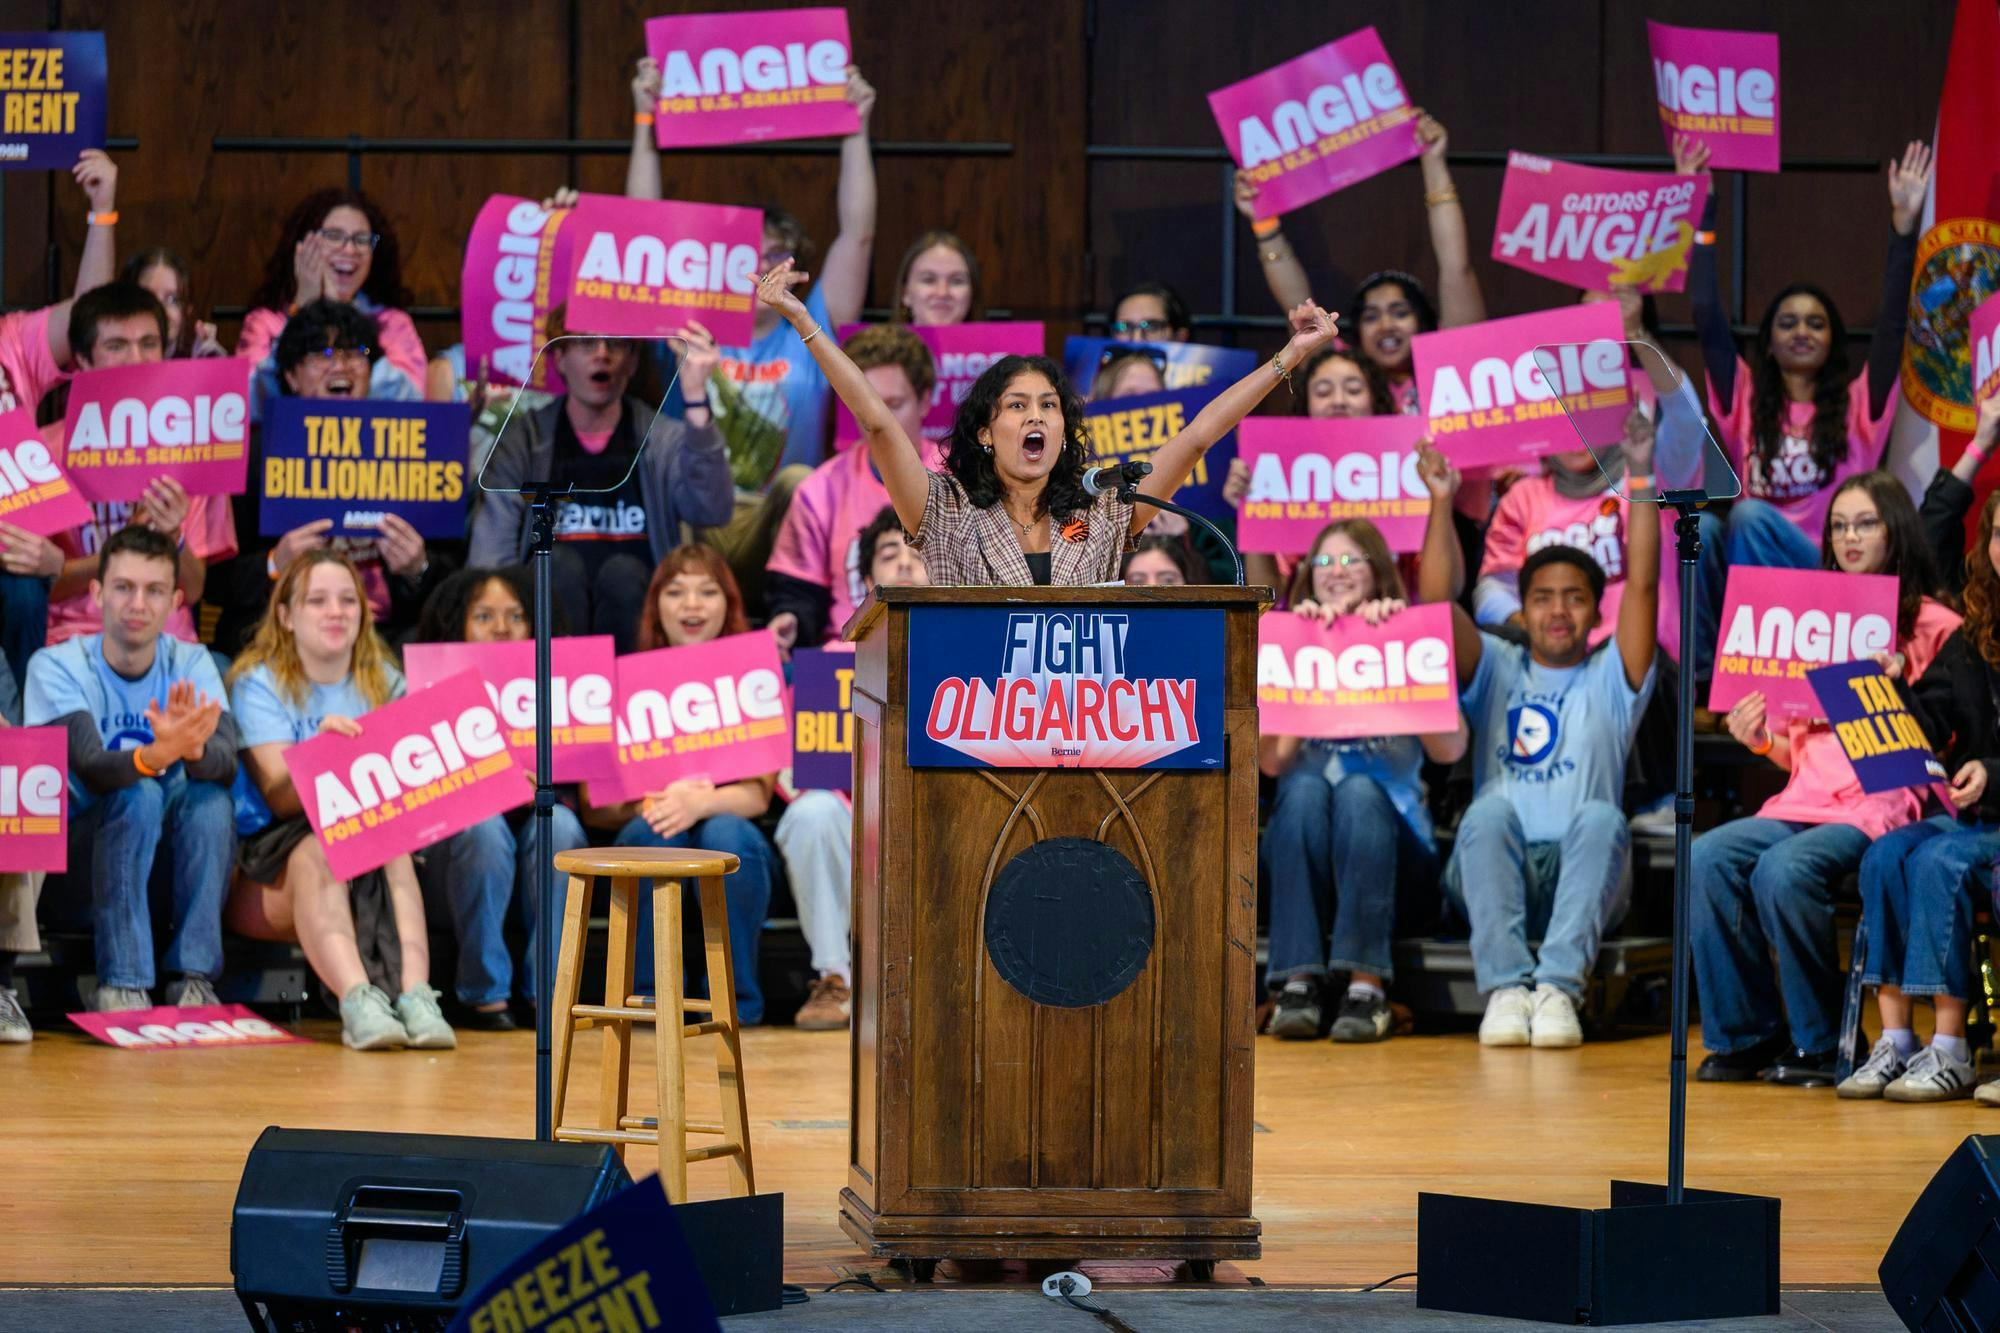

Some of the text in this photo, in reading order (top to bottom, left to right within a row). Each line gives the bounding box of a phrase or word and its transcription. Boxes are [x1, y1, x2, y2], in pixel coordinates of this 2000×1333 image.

[661, 39, 848, 97] ANGIE
[4, 92, 80, 134] RENT
[659, 97, 697, 114] FOR
[741, 86, 813, 108] SENATE
[1238, 62, 1406, 168] ANGIE
[1562, 181, 1696, 214] GATORS FOR
[1500, 200, 1692, 263] ANGIE
[577, 231, 759, 294] ANGIE
[575, 280, 727, 310] FOR U.S. SENATE
[1428, 338, 1626, 417] ANGIE
[68, 392, 246, 450] ANGIE
[304, 416, 427, 459] TAX THE
[1430, 393, 1589, 435] FOR U.S. SENATE
[67, 445, 212, 468] FOR U.S. SENATE
[264, 457, 464, 502] BILLIONAIRES
[555, 500, 646, 533] ernie
[1245, 501, 1402, 520] FOR U.S. SENATE
[1002, 613, 1129, 675] FIGHT
[1722, 605, 1891, 663] ANGIE
[1257, 637, 1450, 691] ANGIE
[1719, 656, 1749, 674] FOR
[1751, 658, 1784, 677] U.S.
[484, 673, 613, 730] GIE
[926, 676, 1200, 743] OLIGARCHY
[673, 725, 748, 754] SENATE
[1051, 746, 1081, 756] Bernie
[314, 706, 506, 828] ANGIE
[323, 767, 477, 845] FOR U.S. SENATE
[468, 1228, 620, 1333] FREEZE
